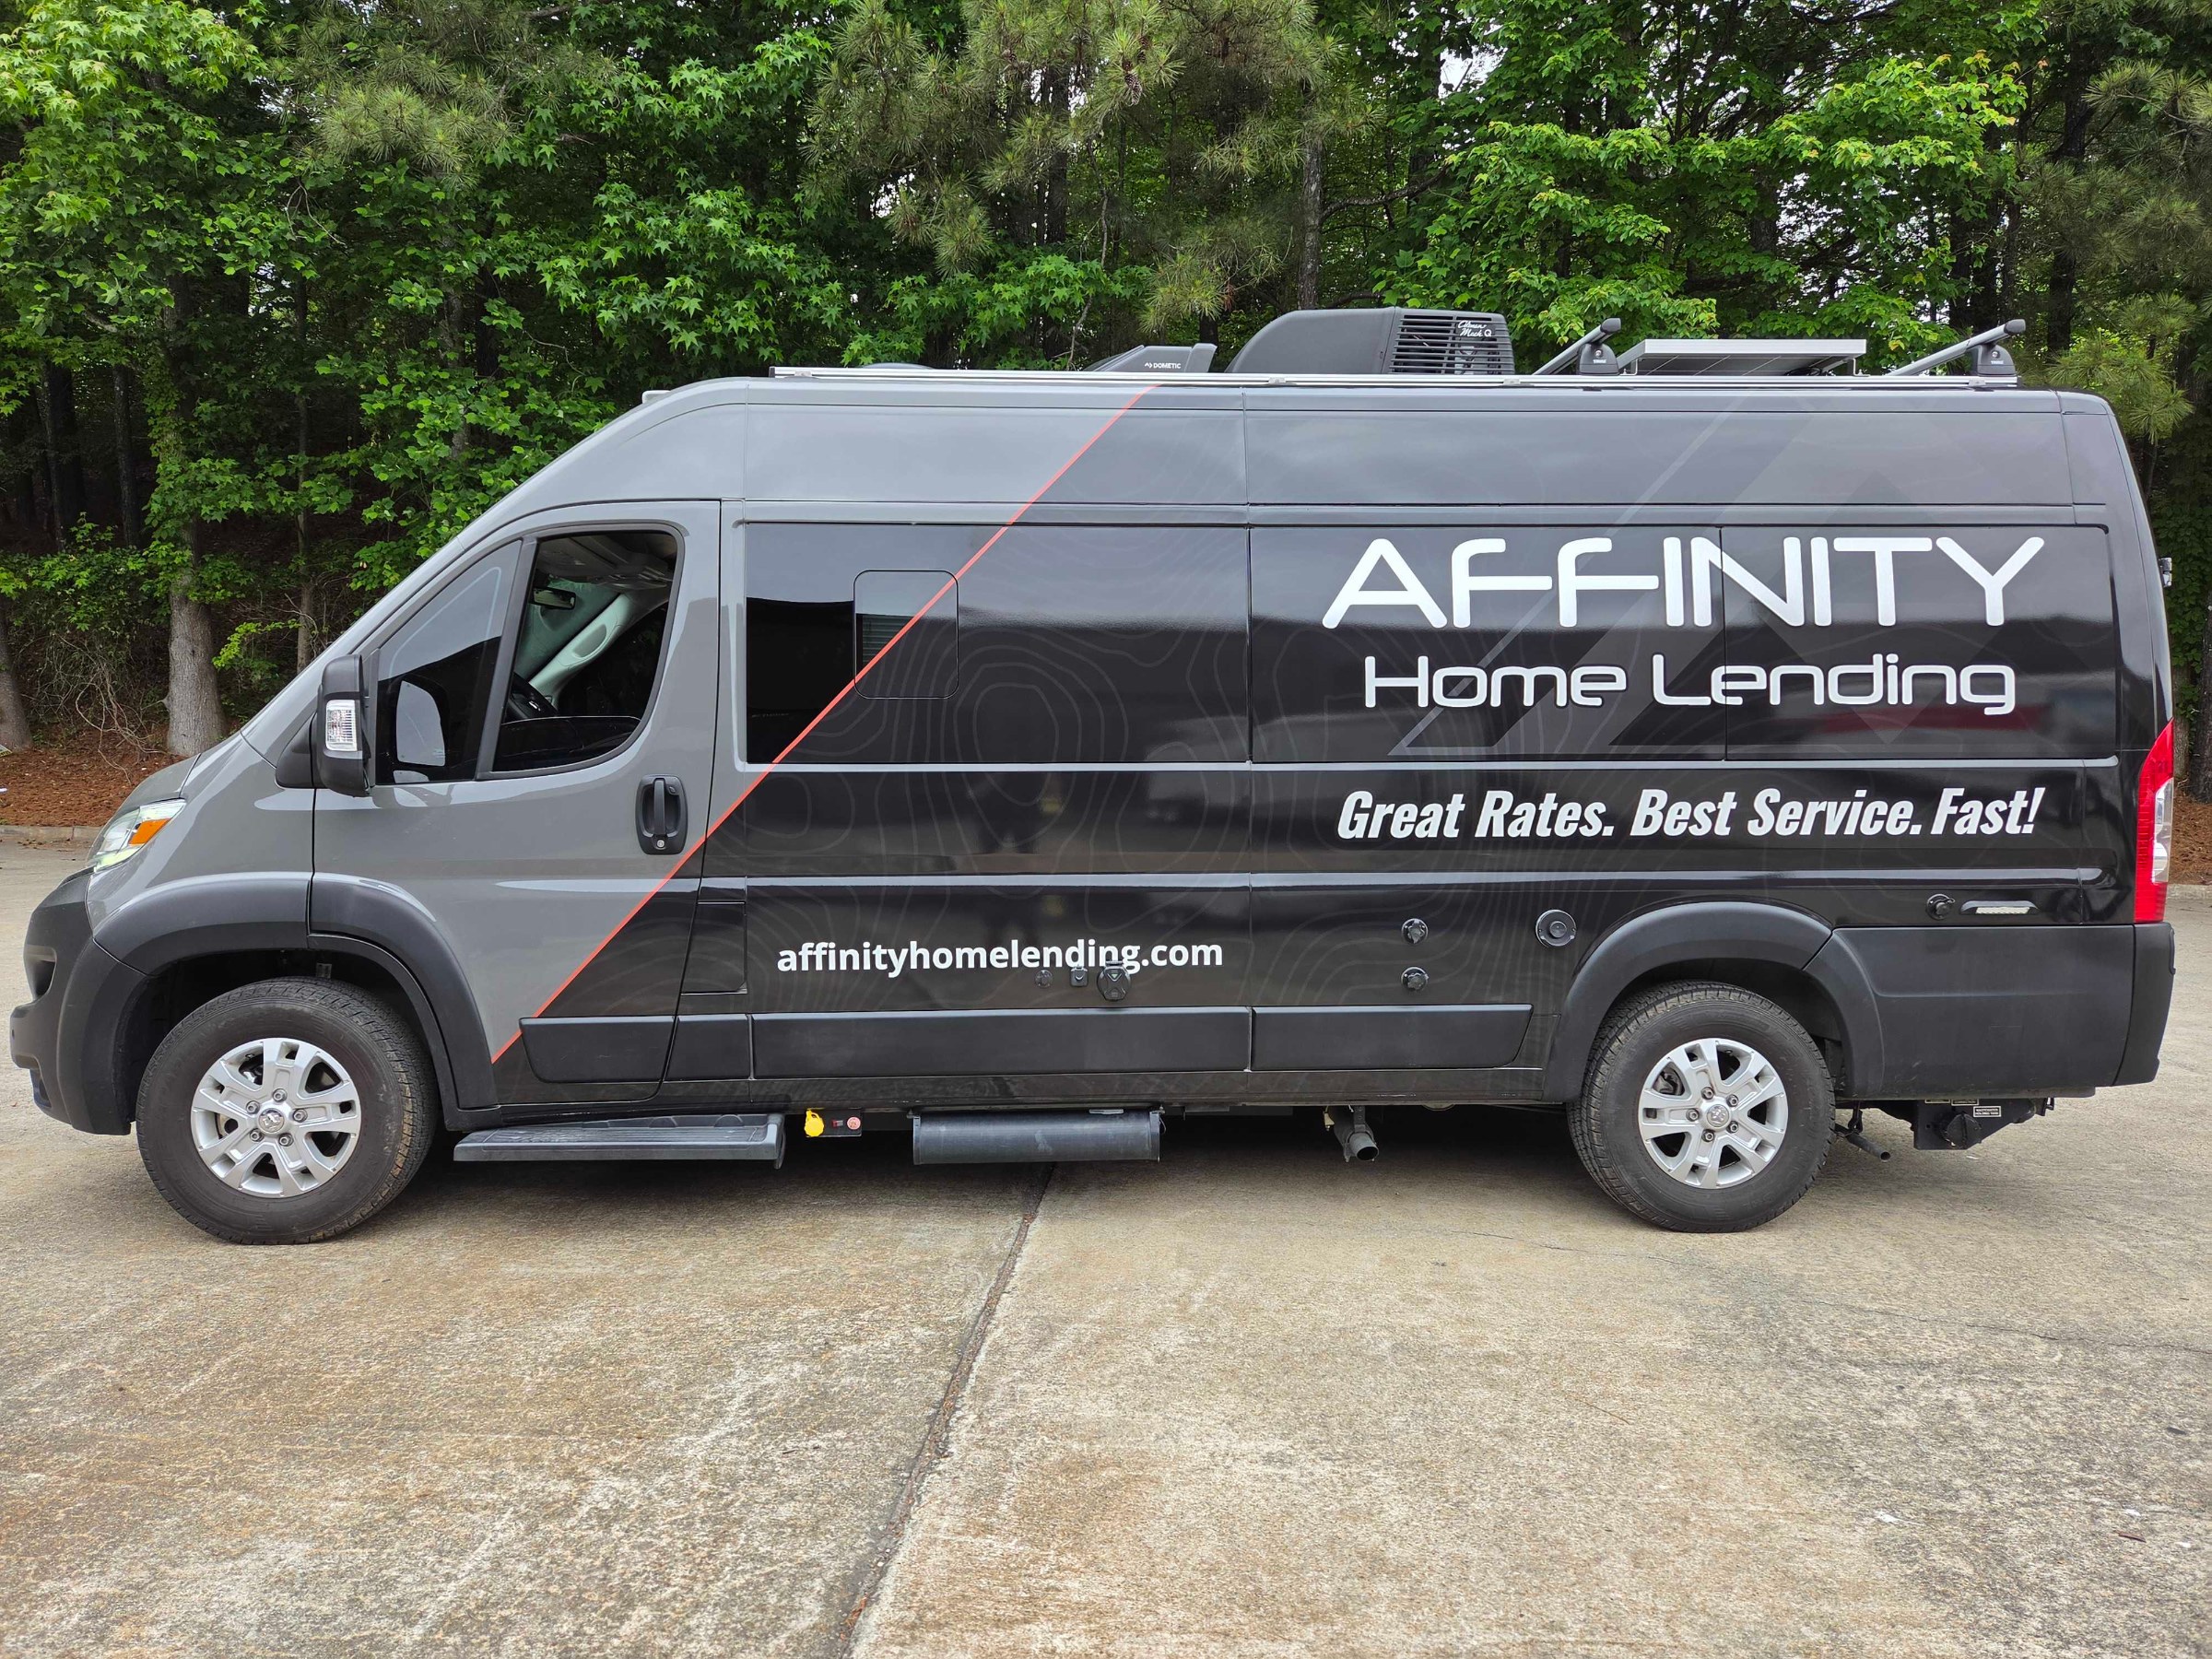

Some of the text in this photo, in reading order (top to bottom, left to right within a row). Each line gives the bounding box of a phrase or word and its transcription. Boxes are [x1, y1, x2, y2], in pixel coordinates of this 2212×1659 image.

[1322, 536, 2045, 629] AFFINITY
[1364, 653, 2017, 716] Home Lending
[1336, 787, 2047, 840] Great Rates. Best Service. Fast!
[777, 938, 1224, 978] affinityhomelending.com
